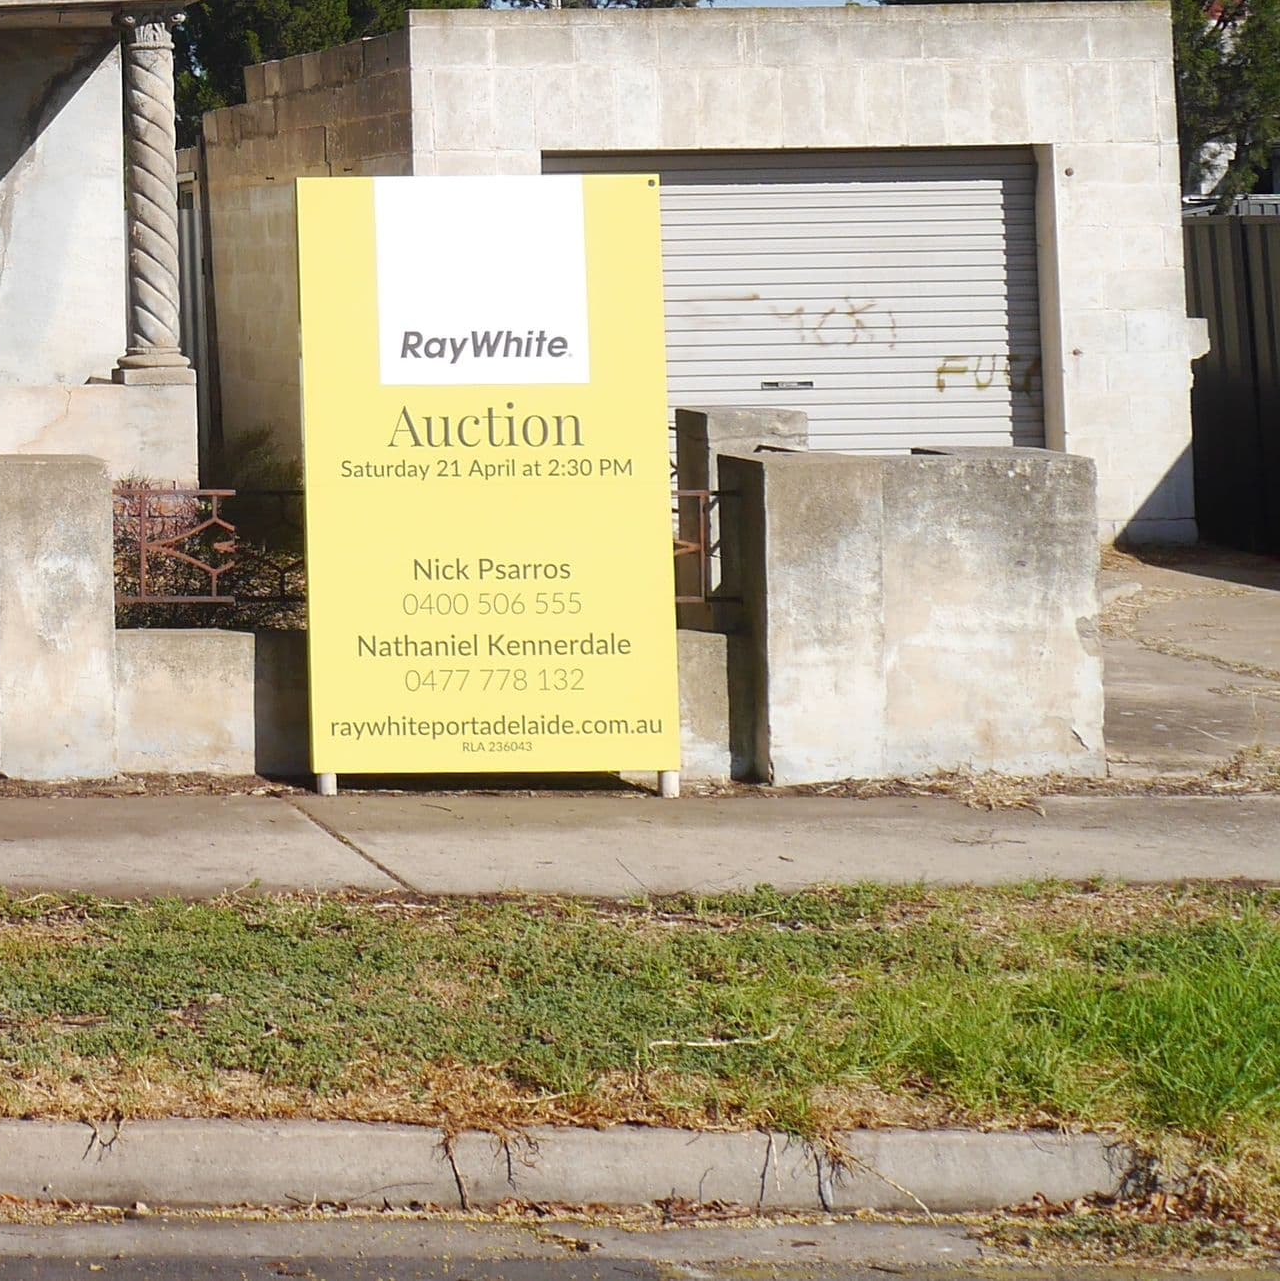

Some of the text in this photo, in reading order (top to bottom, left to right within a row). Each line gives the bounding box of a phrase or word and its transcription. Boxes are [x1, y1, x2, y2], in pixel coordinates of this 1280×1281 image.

[400, 330, 569, 365] RayWhite
[387, 401, 585, 448] Auction
[341, 458, 633, 481] Saturday 21 April at 2:30 PM
[413, 557, 571, 581] Nick Psarros
[402, 591, 583, 616] 0400 506 555
[357, 632, 632, 657] Nathaniel Kennerdale
[404, 668, 585, 692] 0477 778 132
[330, 714, 663, 740] raywhiteportadelaide.com.au
[462, 740, 533, 752] RLA 236043
